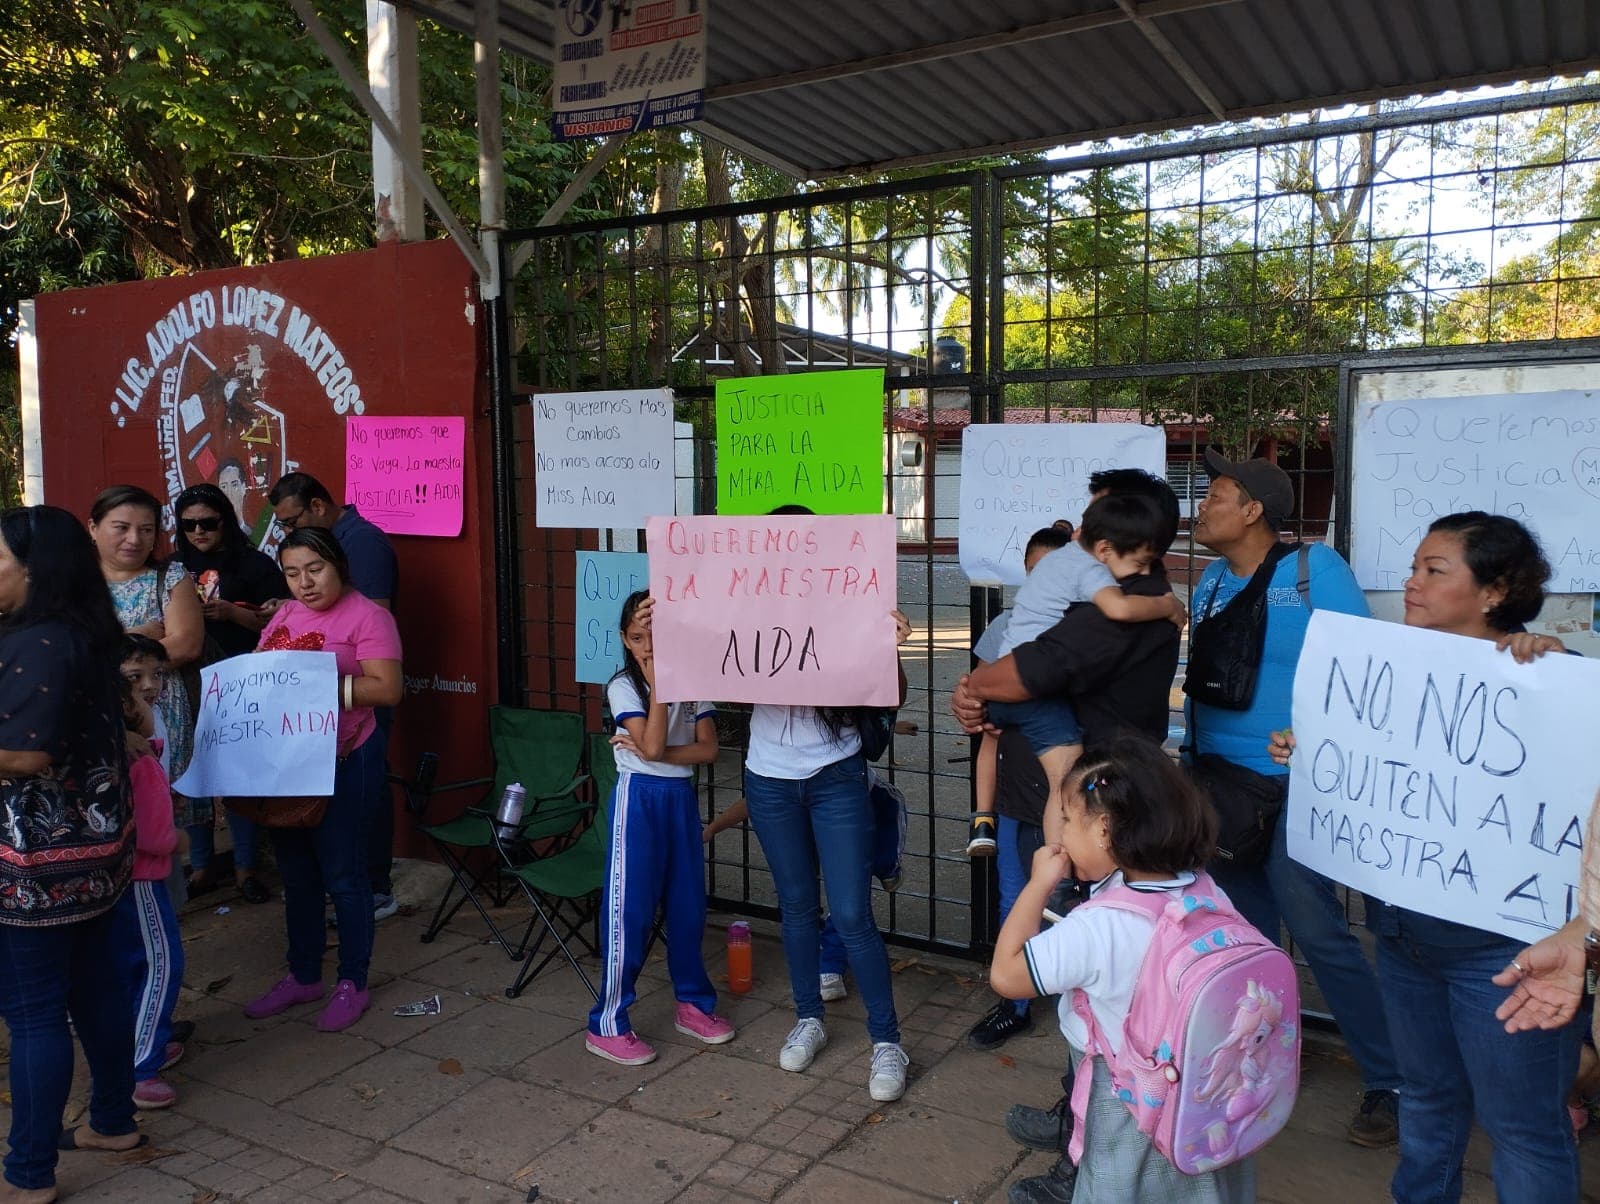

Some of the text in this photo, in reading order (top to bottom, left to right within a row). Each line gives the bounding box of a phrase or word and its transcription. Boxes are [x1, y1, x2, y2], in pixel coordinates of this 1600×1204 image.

[665, 108, 695, 123] MERCADO
[146, 290, 216, 368] ADOLFO
[222, 286, 286, 338] LOPEZ
[538, 400, 557, 421] No
[564, 398, 632, 422] queremos
[725, 389, 826, 425] JUSTICIA
[350, 422, 450, 448] No queremos que
[566, 425, 621, 442] Cambios
[730, 430, 814, 456] PARA LA
[424, 456, 461, 471] maestra
[537, 452, 555, 473] No
[560, 456, 590, 470] mas
[595, 456, 635, 470] acoso
[982, 439, 1120, 479] Queremos
[434, 482, 461, 500] AIDA
[794, 461, 864, 495] AIDA
[974, 498, 986, 510] a
[666, 521, 868, 556] QUEREMOS A
[664, 566, 880, 602] LA MAESTRA
[584, 618, 614, 661] SE
[722, 626, 821, 678] AIDA
[204, 671, 301, 715] Apoyamos
[432, 673, 477, 694] Anuncios
[243, 698, 259, 714] la
[281, 710, 336, 736] AIDA
[1416, 672, 1526, 778] NOS
[1312, 738, 1584, 856] QUITEN A LA
[1311, 806, 1478, 894] MAESTRA
